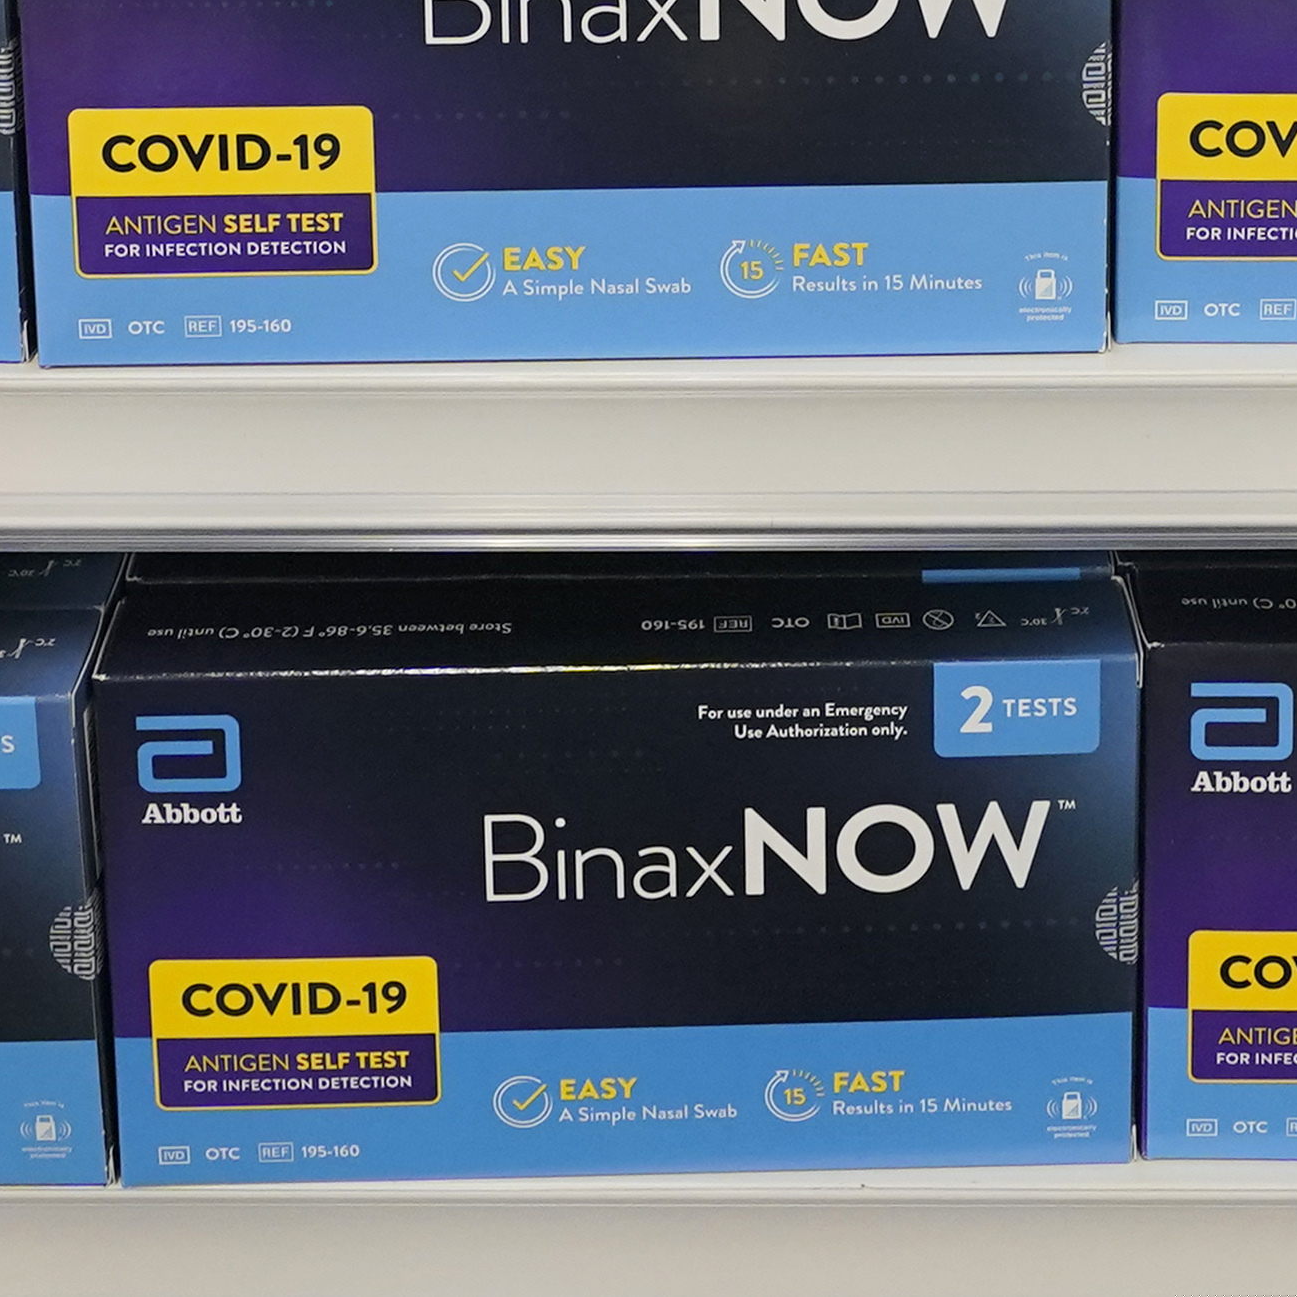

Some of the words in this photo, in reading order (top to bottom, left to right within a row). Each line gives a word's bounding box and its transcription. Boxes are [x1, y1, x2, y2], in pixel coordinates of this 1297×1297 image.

[102, 133, 340, 172] COVID-19
[106, 214, 217, 235] ANTIGEN
[223, 214, 281, 233] SELF
[287, 213, 344, 232] TEST
[1186, 227, 1222, 240] FOR
[503, 246, 586, 272] EASY
[793, 243, 868, 267] FAST
[959, 685, 993, 733] 2
[1003, 697, 1077, 718] TESTS
[1191, 772, 1292, 793] Abbott
[142, 803, 242, 825] Abbott
[182, 981, 407, 1017] COVID-19
[185, 1054, 289, 1072] ANTIGEN
[296, 1053, 351, 1071] SELF
[356, 1051, 410, 1068] TEST
[184, 1079, 218, 1092] FOR
[222, 1077, 312, 1091] INFECTION
[319, 1075, 412, 1089] DETECTION
[560, 1077, 637, 1099] EASY
[834, 1070, 904, 1092] FAST
[1190, 1123, 1213, 1133] IVD
[1233, 1120, 1268, 1133] OTC
